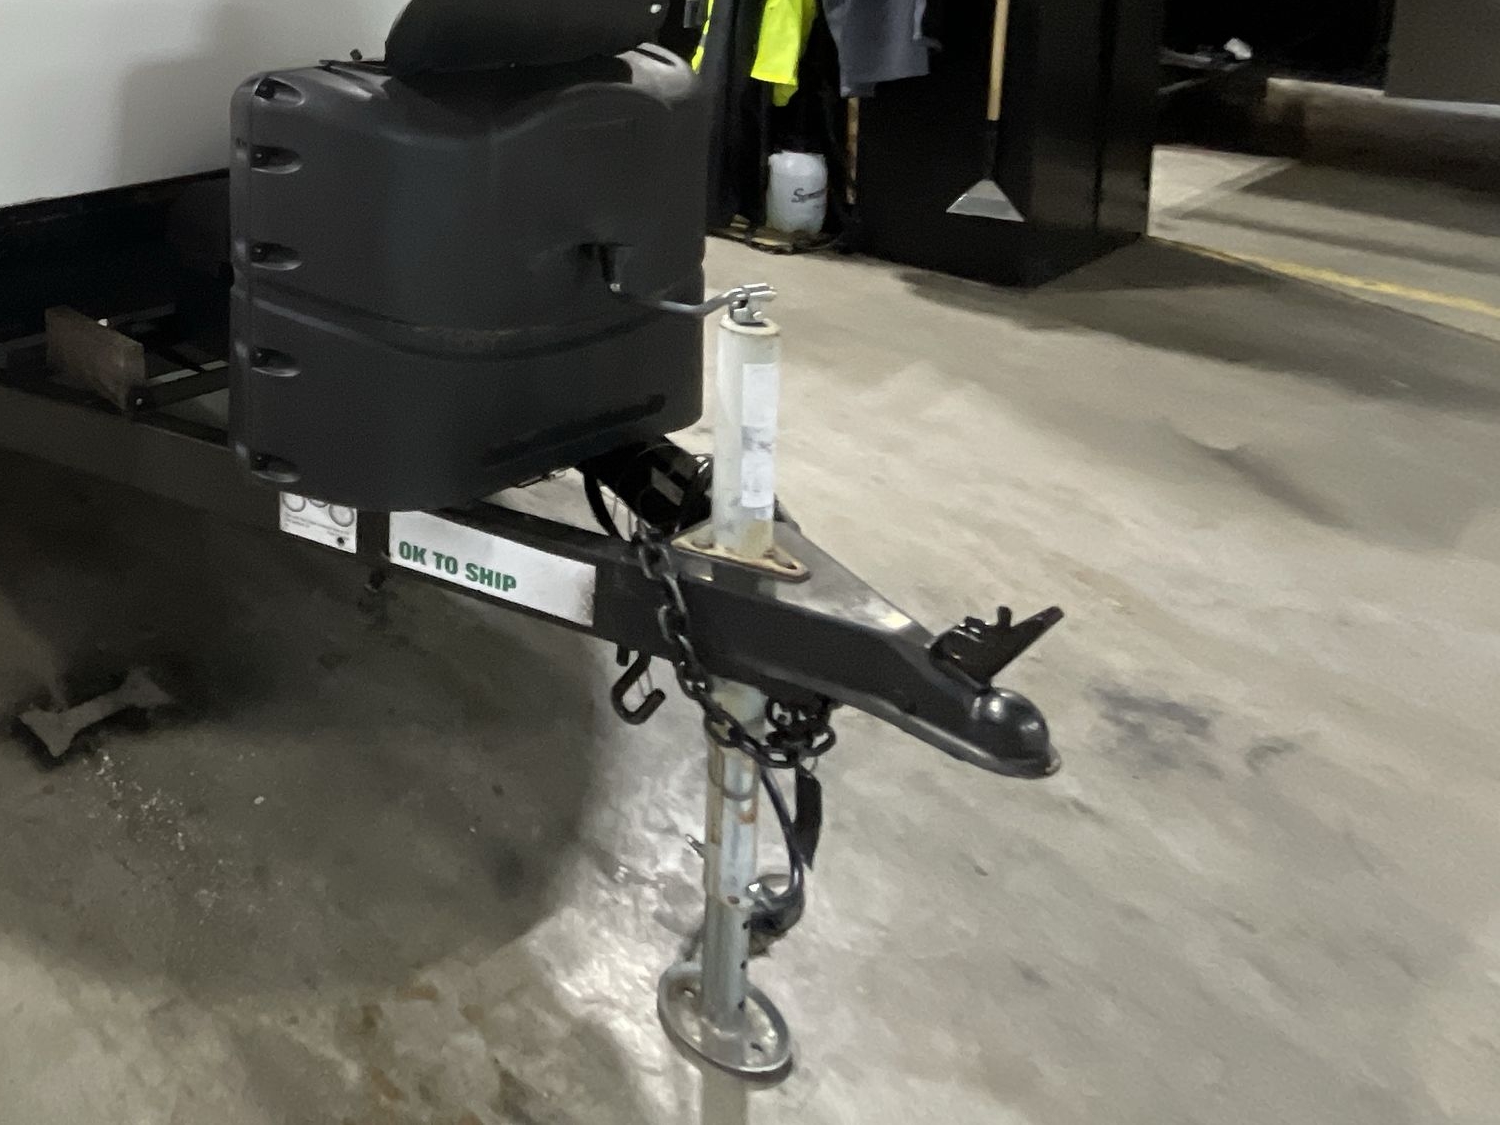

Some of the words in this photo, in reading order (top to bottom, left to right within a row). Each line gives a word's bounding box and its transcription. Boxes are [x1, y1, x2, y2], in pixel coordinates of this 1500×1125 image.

[399, 541, 427, 565] OK
[433, 552, 457, 575] TO
[466, 562, 517, 592] SHIP
